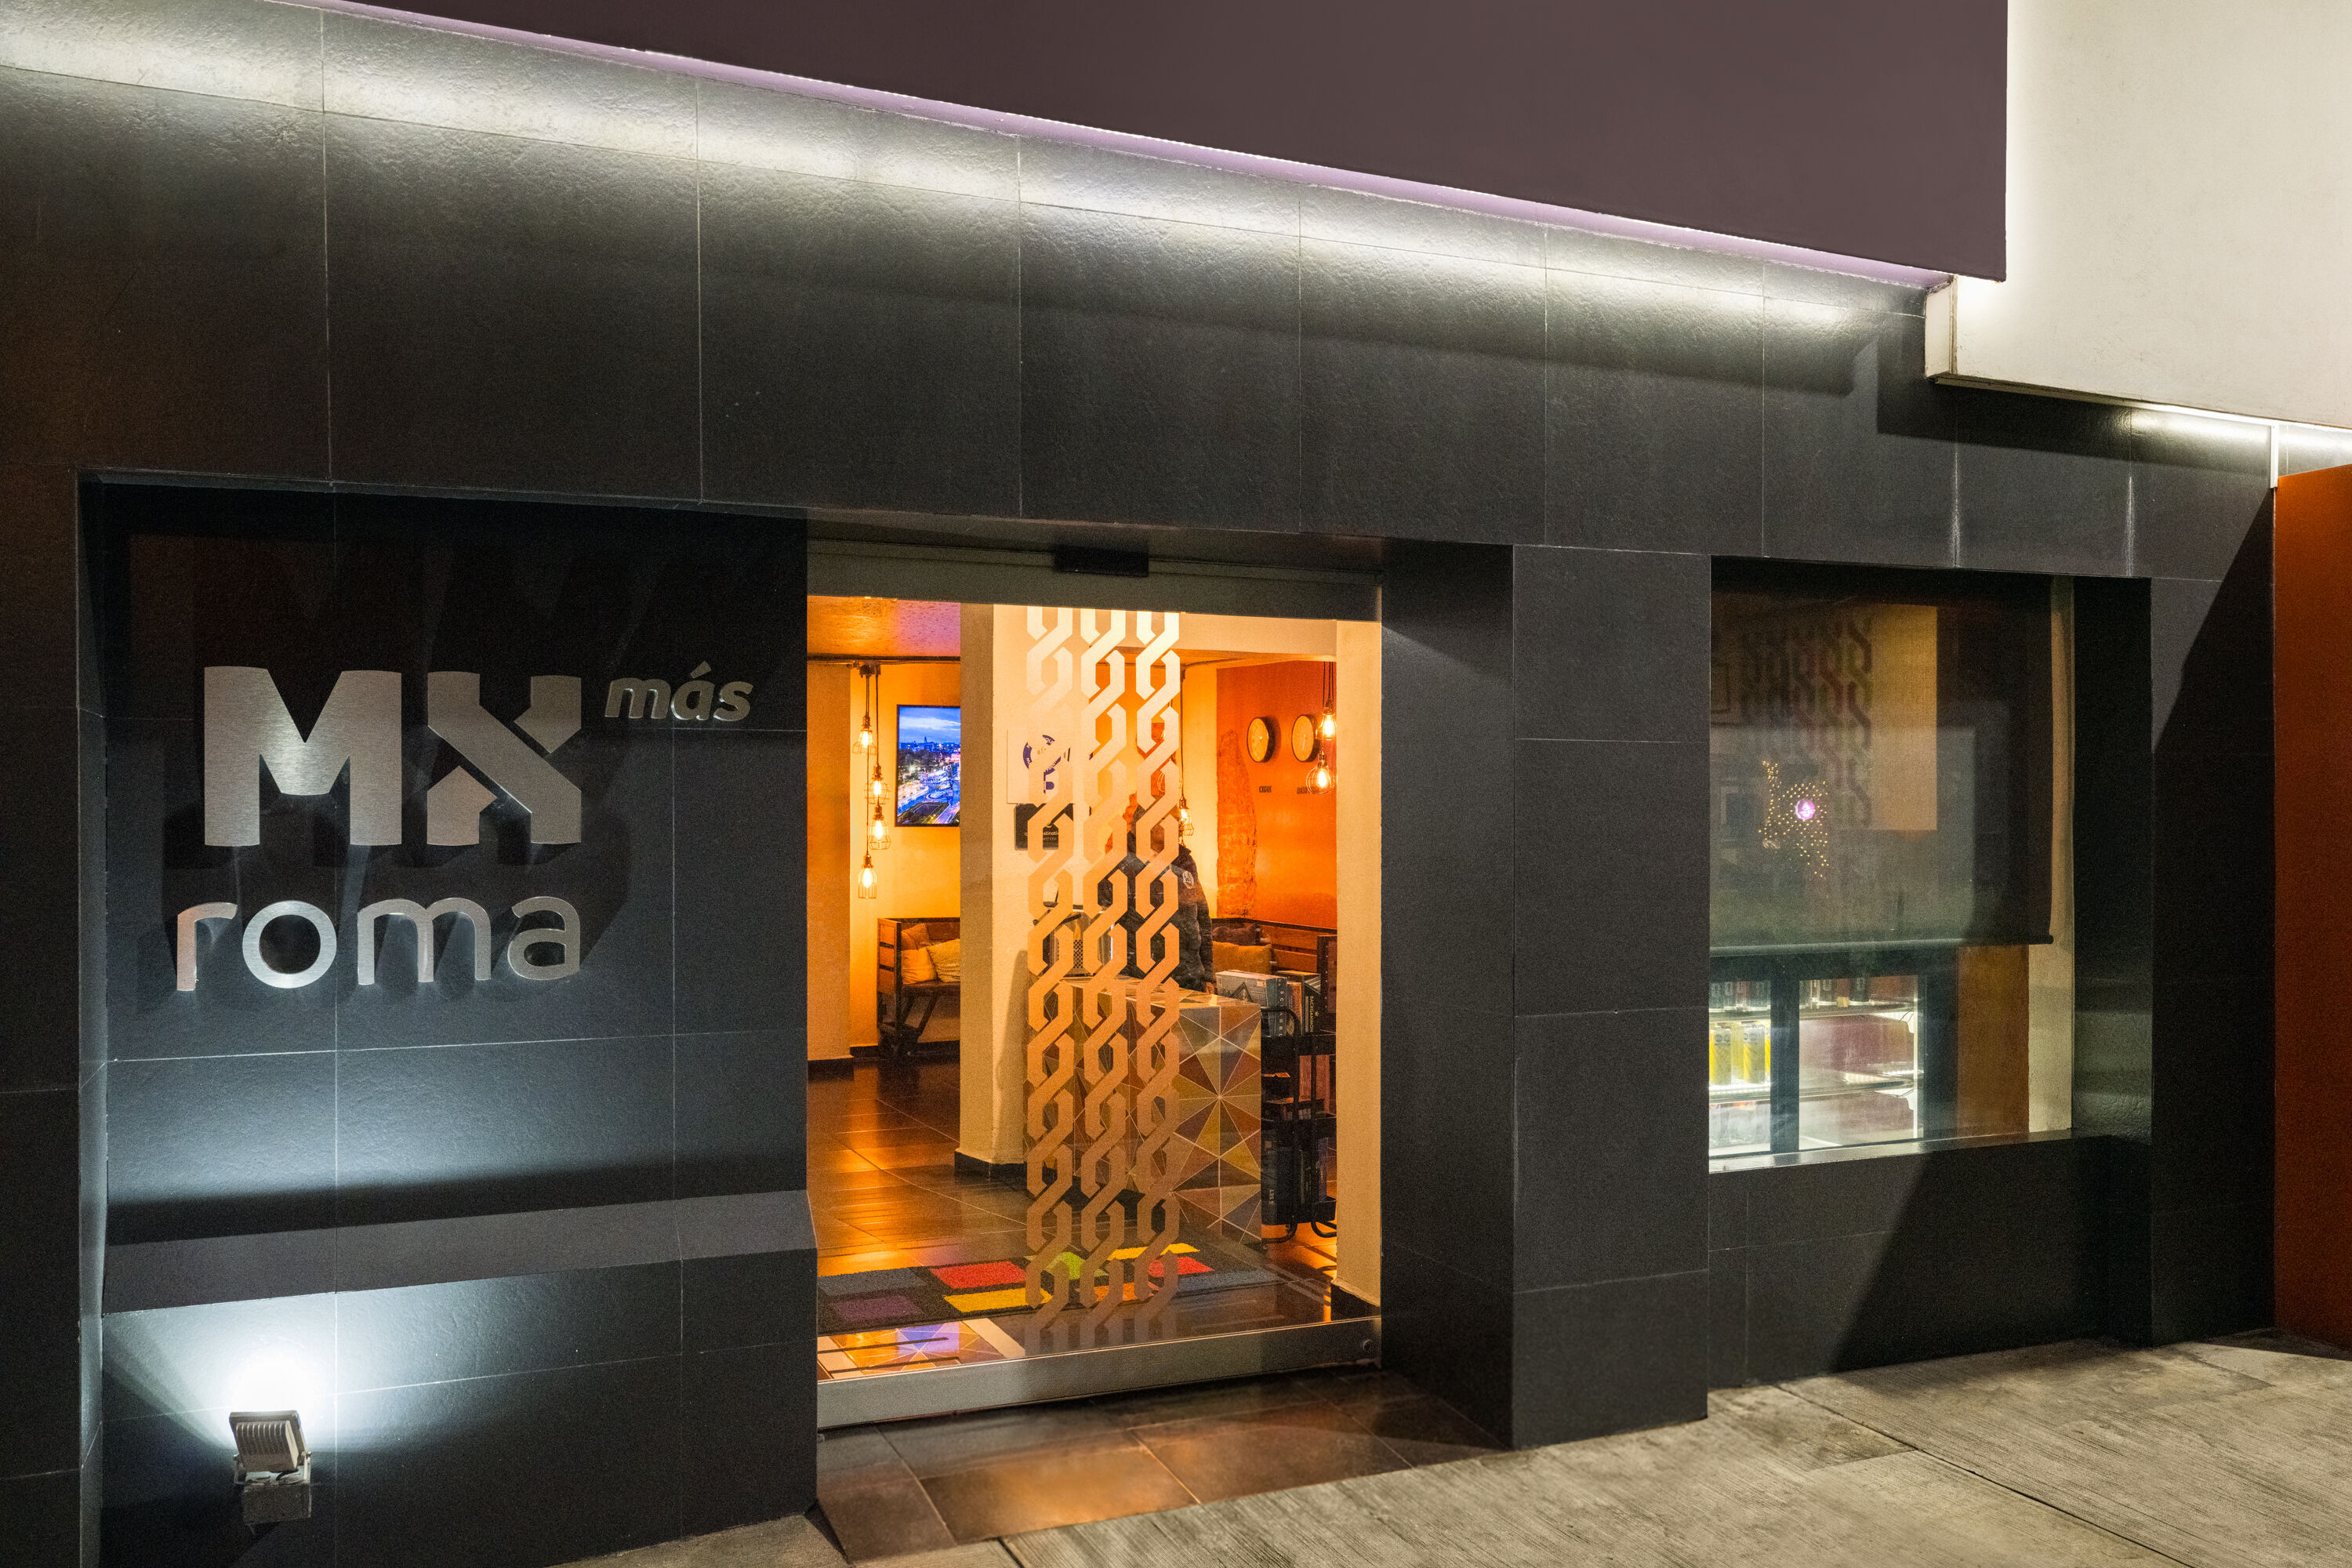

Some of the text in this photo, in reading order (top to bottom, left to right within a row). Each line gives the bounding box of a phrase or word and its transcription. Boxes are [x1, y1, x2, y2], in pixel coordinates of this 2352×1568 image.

[204, 660, 753, 845] MX más
[176, 895, 580, 991] roma
